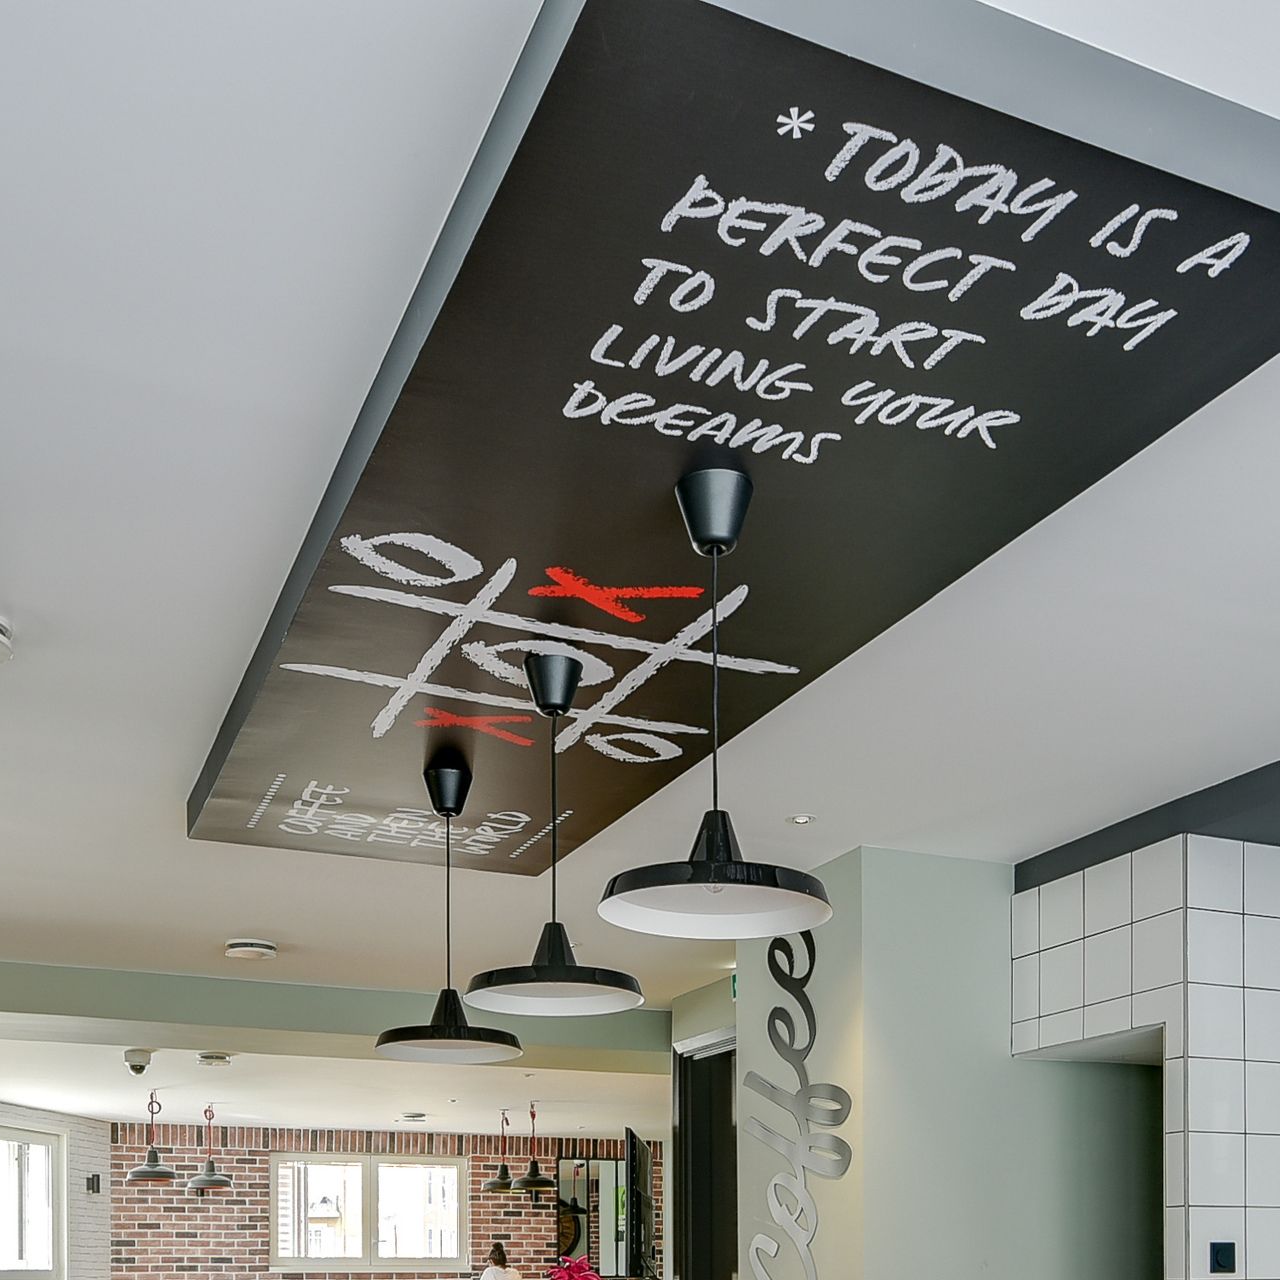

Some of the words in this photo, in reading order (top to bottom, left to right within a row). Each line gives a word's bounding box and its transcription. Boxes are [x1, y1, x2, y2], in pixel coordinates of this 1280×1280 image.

[824, 121, 1077, 242] TODAY
[1089, 203, 1178, 258] IS
[1176, 232, 1250, 277] A
[661, 174, 1016, 301] PERFECT
[1020, 272, 1180, 352] DAY
[634, 258, 716, 313] TO
[746, 288, 986, 370] START
[590, 324, 813, 401] LIVING
[841, 381, 1020, 449] YOUR
[562, 381, 841, 464] DREAMS
[278, 780, 350, 835] COFFEE
[324, 813, 377, 840] AND
[367, 807, 433, 844] THEN
[410, 821, 468, 848] THE
[453, 811, 531, 855] WORLD
